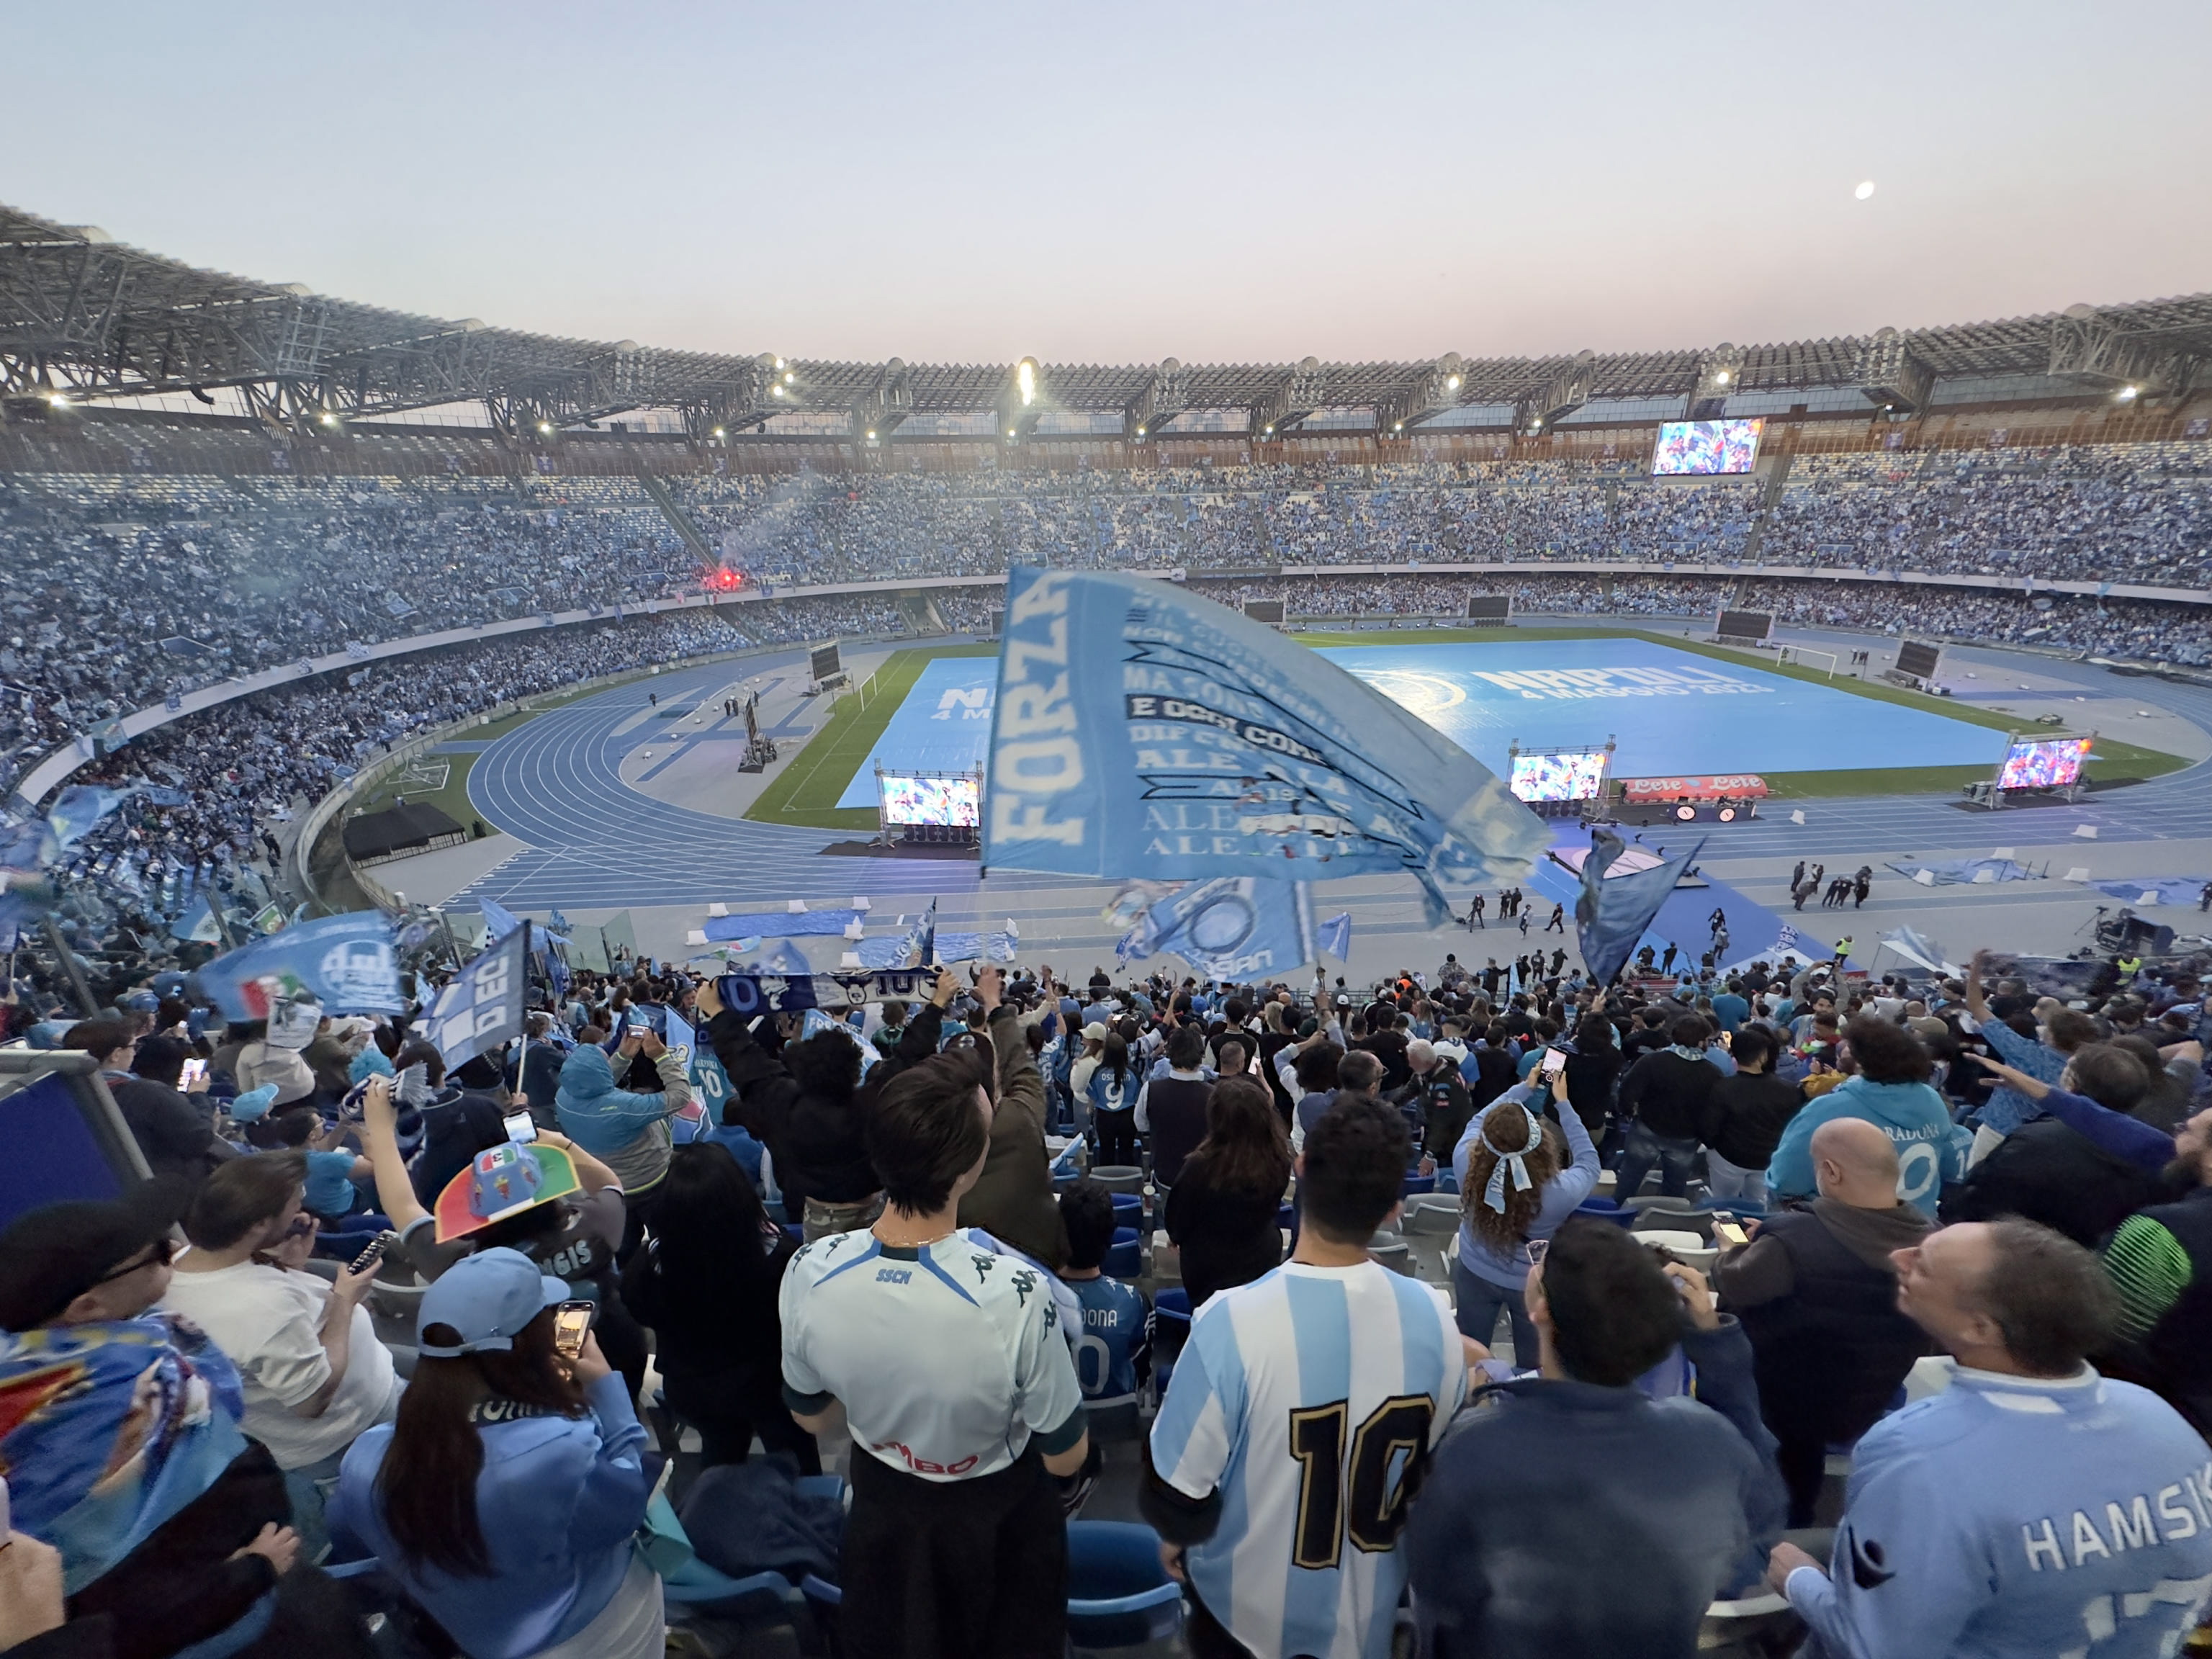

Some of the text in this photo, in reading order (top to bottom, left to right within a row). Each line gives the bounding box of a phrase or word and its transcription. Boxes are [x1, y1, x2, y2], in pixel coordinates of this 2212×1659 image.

[1123, 665, 1174, 692] MA
[1470, 665, 1746, 691] NAPOLI
[1544, 683, 1691, 699] MAGGIO
[1686, 683, 1777, 695] 2023
[930, 709, 950, 720] 4
[991, 572, 1086, 848] FORZA
[1131, 697, 1156, 716] E
[1136, 749, 1243, 770] ALE
[1629, 779, 1683, 793] Lete
[1709, 776, 1762, 791] Lete
[1141, 804, 1240, 832] ALE
[1143, 835, 1241, 856] ALE
[698, 1069, 723, 1098] 10
[1105, 1082, 1125, 1110] 9
[876, 1268, 912, 1285] SSCN
[1289, 1391, 1436, 1570] 10
